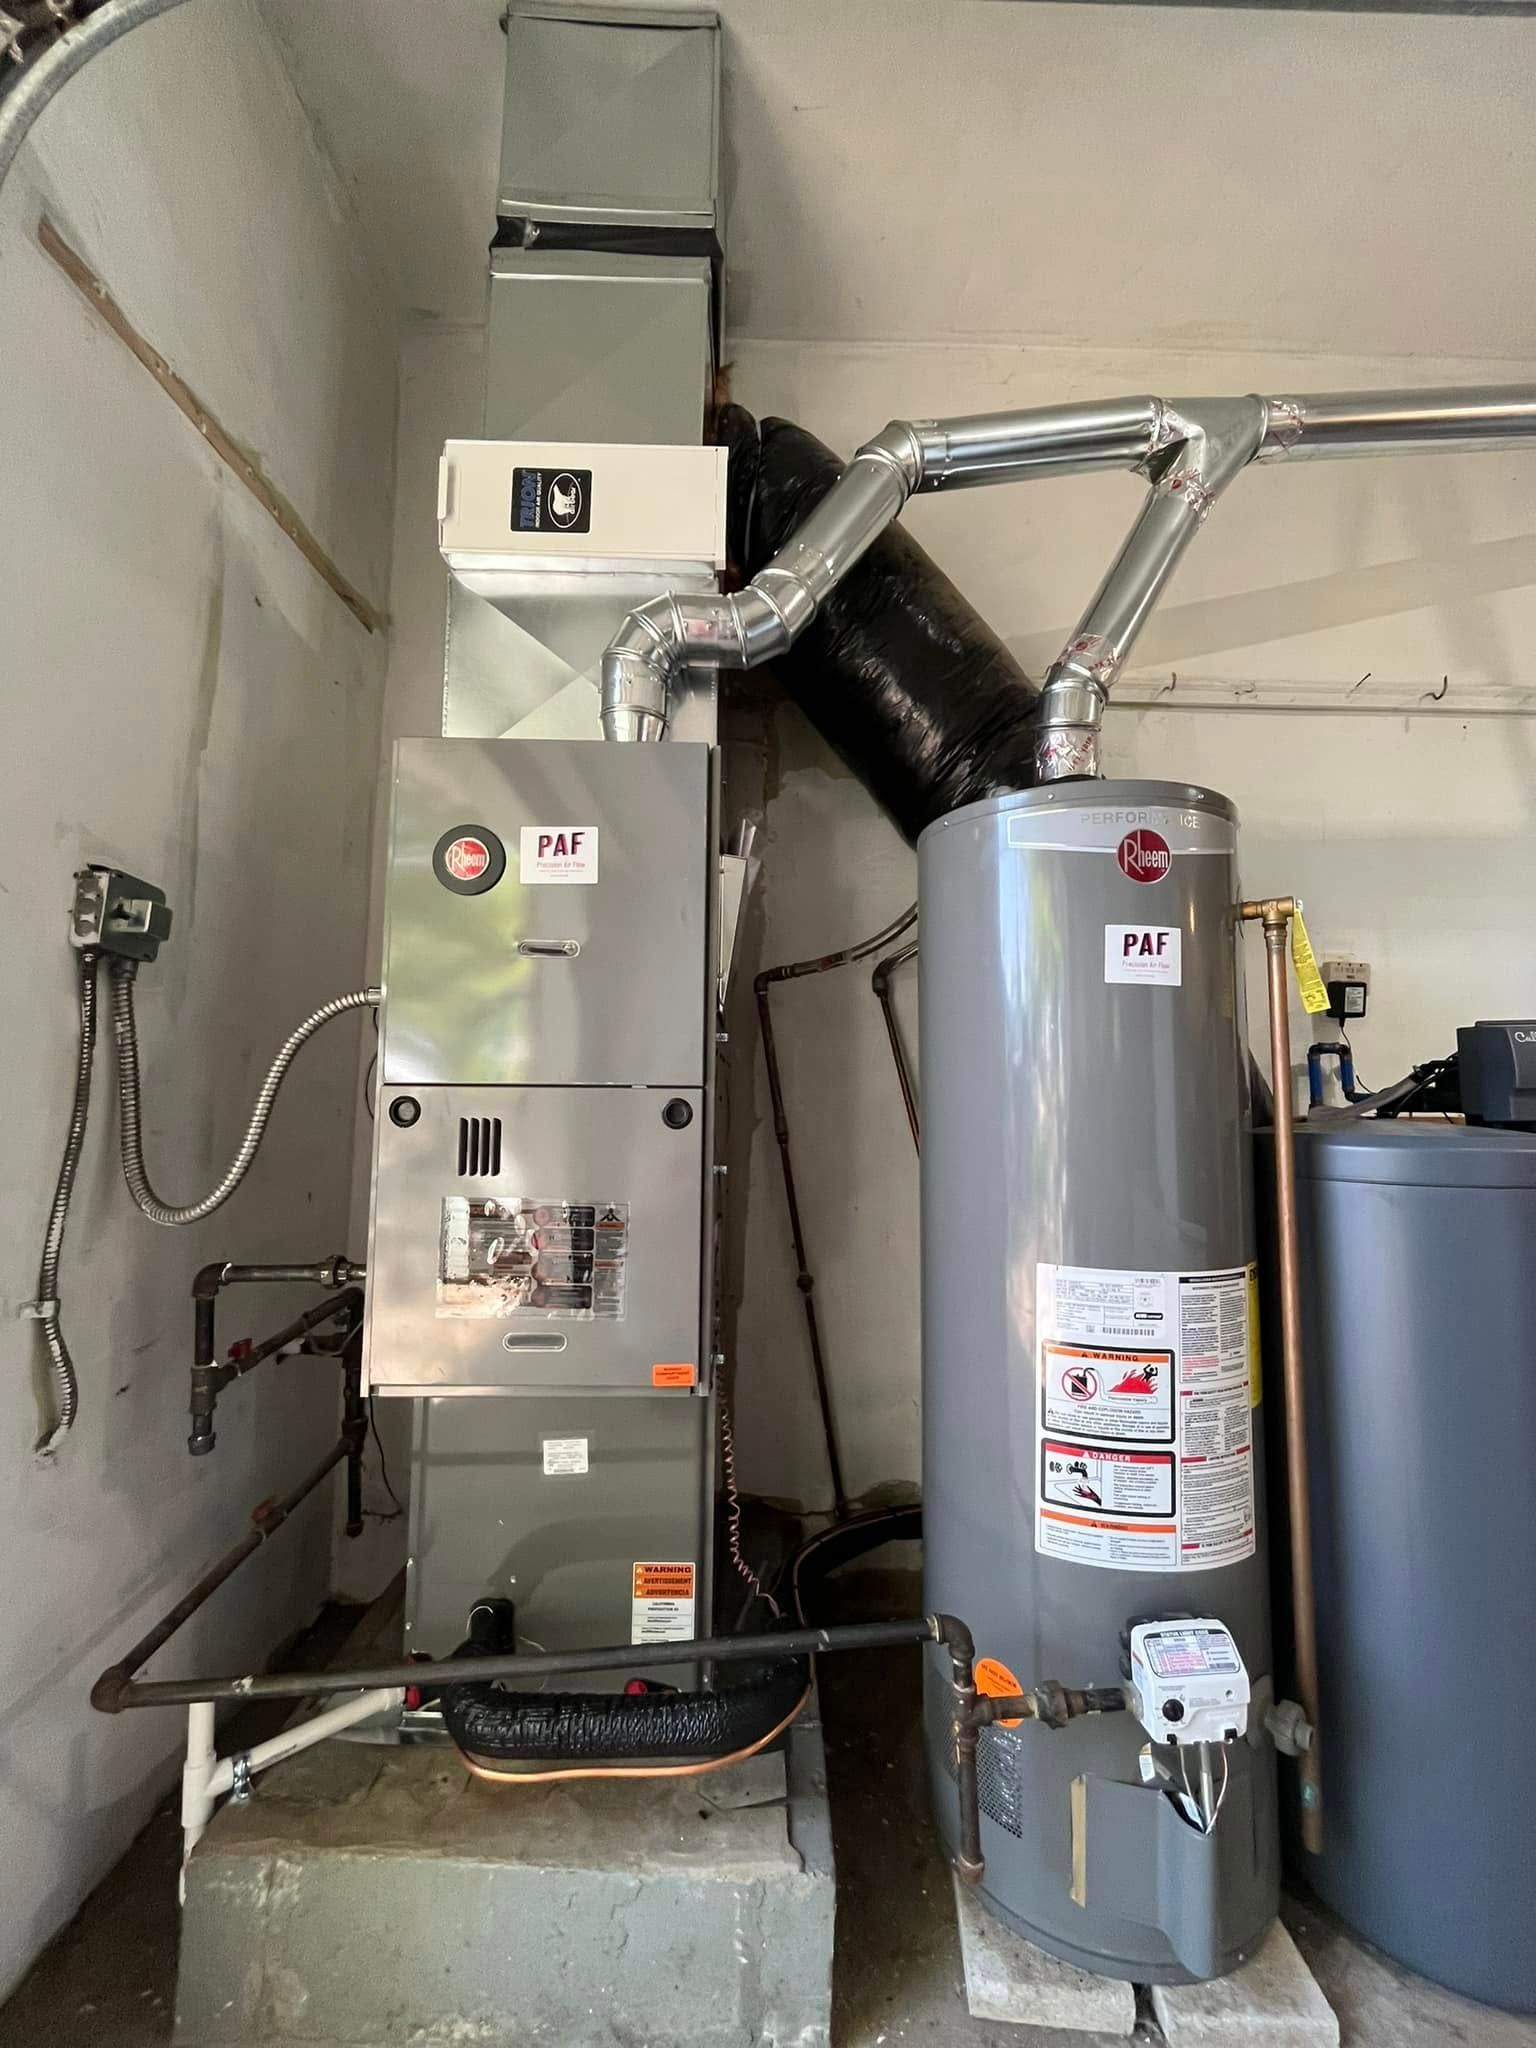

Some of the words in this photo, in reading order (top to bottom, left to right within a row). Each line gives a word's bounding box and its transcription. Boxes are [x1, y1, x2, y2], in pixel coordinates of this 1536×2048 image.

[520, 470, 536, 528] TRION
[1080, 811, 1200, 829] PERFORCE
[450, 842, 486, 872] Rheem
[538, 832, 585, 858] PAF
[1123, 830, 1169, 875] Rheem
[1123, 932, 1170, 957] PAF
[1093, 1352, 1139, 1361] WARNING
[1092, 1452, 1131, 1462] DANGER
[644, 1566, 691, 1574] WARNING
